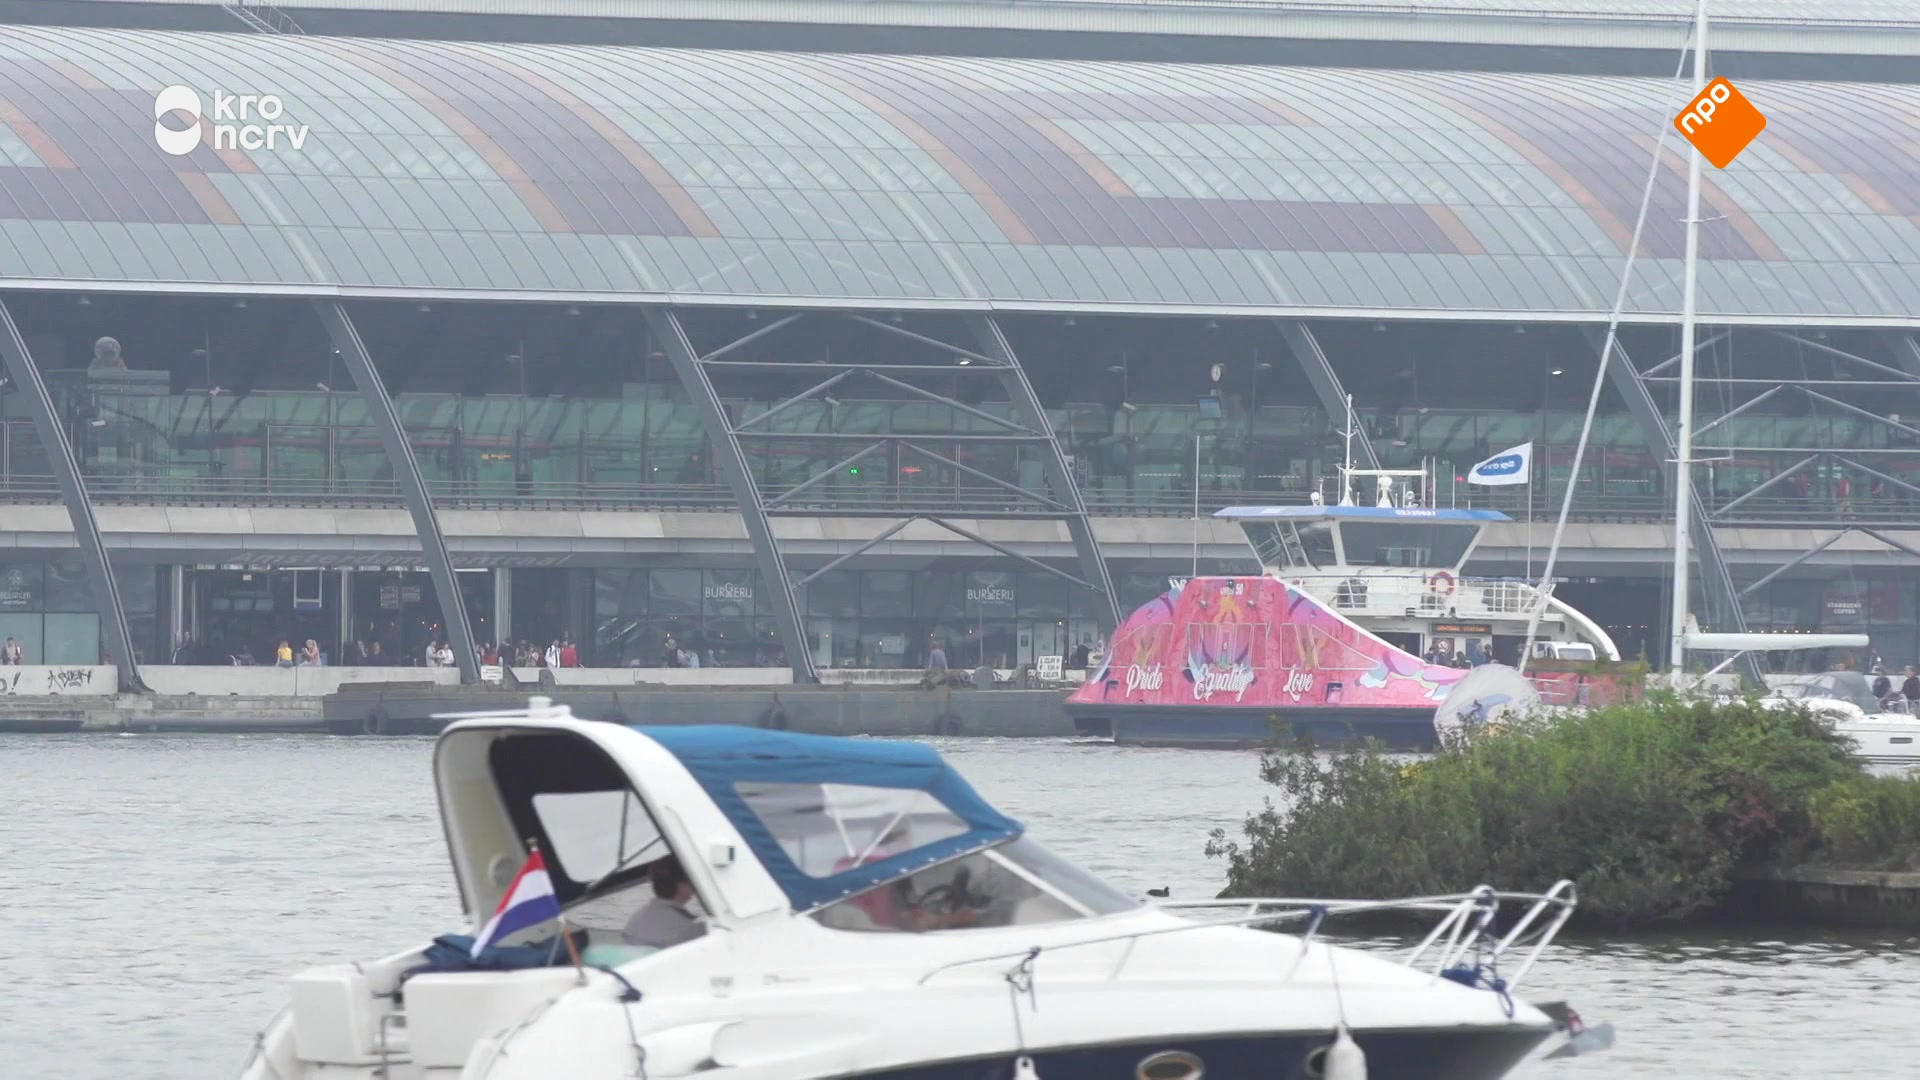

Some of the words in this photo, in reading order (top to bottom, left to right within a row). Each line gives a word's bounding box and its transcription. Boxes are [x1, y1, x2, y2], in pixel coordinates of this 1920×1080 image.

[452, 553, 574, 567] entraal
[705, 582, 753, 598] BURGERIJ
[967, 584, 1014, 600] BURGERIJ
[1126, 662, 1163, 697] Pride
[1193, 664, 1250, 702] Equality
[1283, 664, 1314, 701] Love
